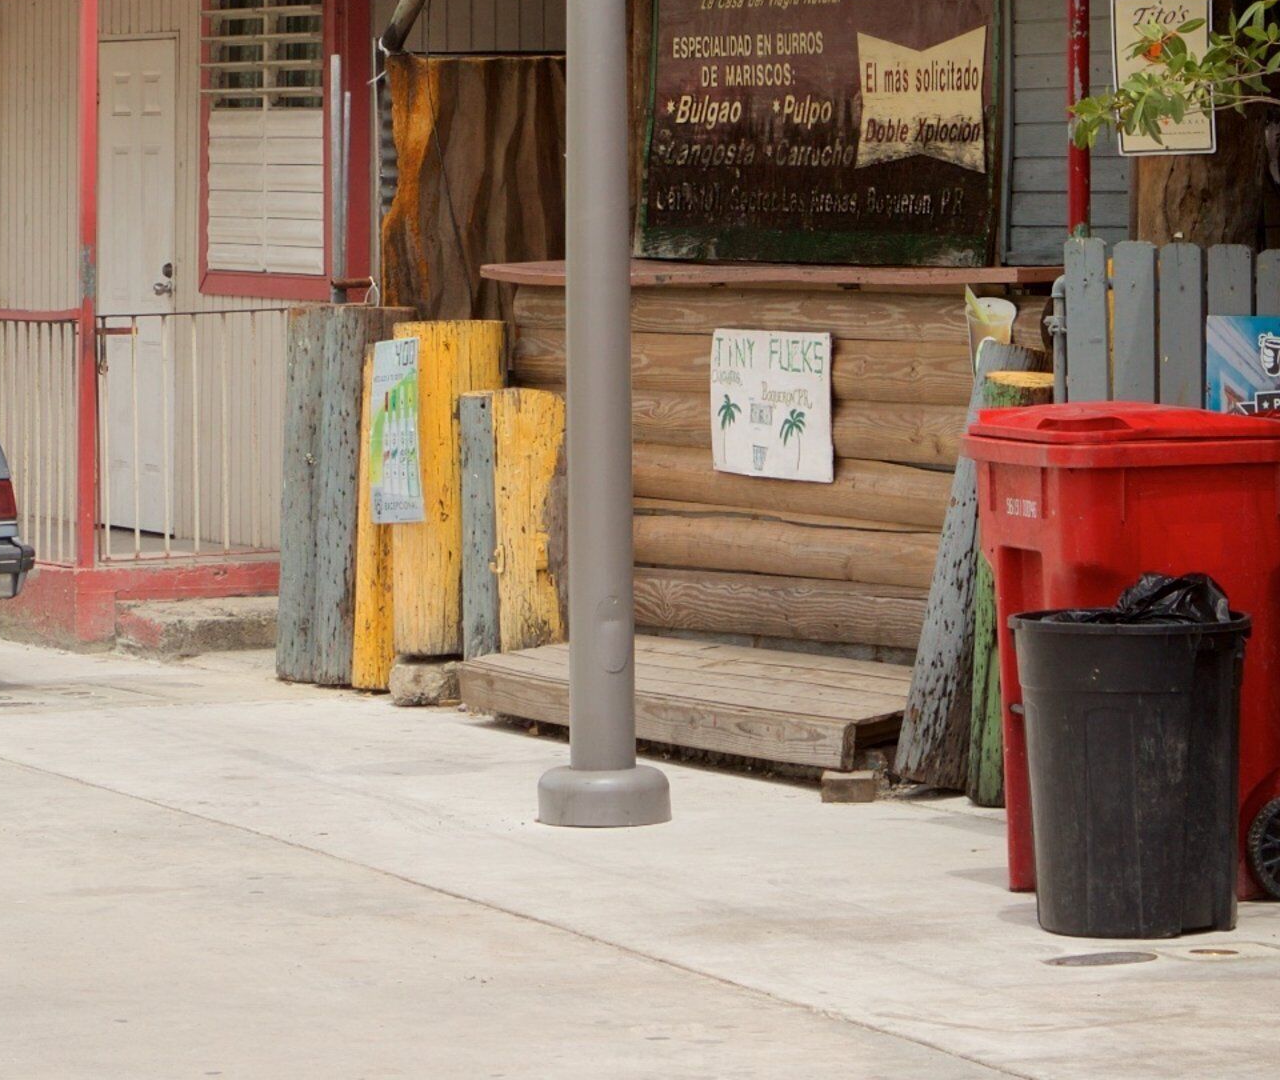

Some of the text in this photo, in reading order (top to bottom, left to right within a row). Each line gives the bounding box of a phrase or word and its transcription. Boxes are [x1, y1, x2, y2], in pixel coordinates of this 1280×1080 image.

[1133, 4, 1190, 27] Tito's
[672, 31, 824, 59] ESPECIALIDAD EN BURROS
[701, 63, 797, 88] DE MARISCOS:
[865, 58, 980, 93] El más solicitado
[864, 117, 981, 146] Doble Xploción
